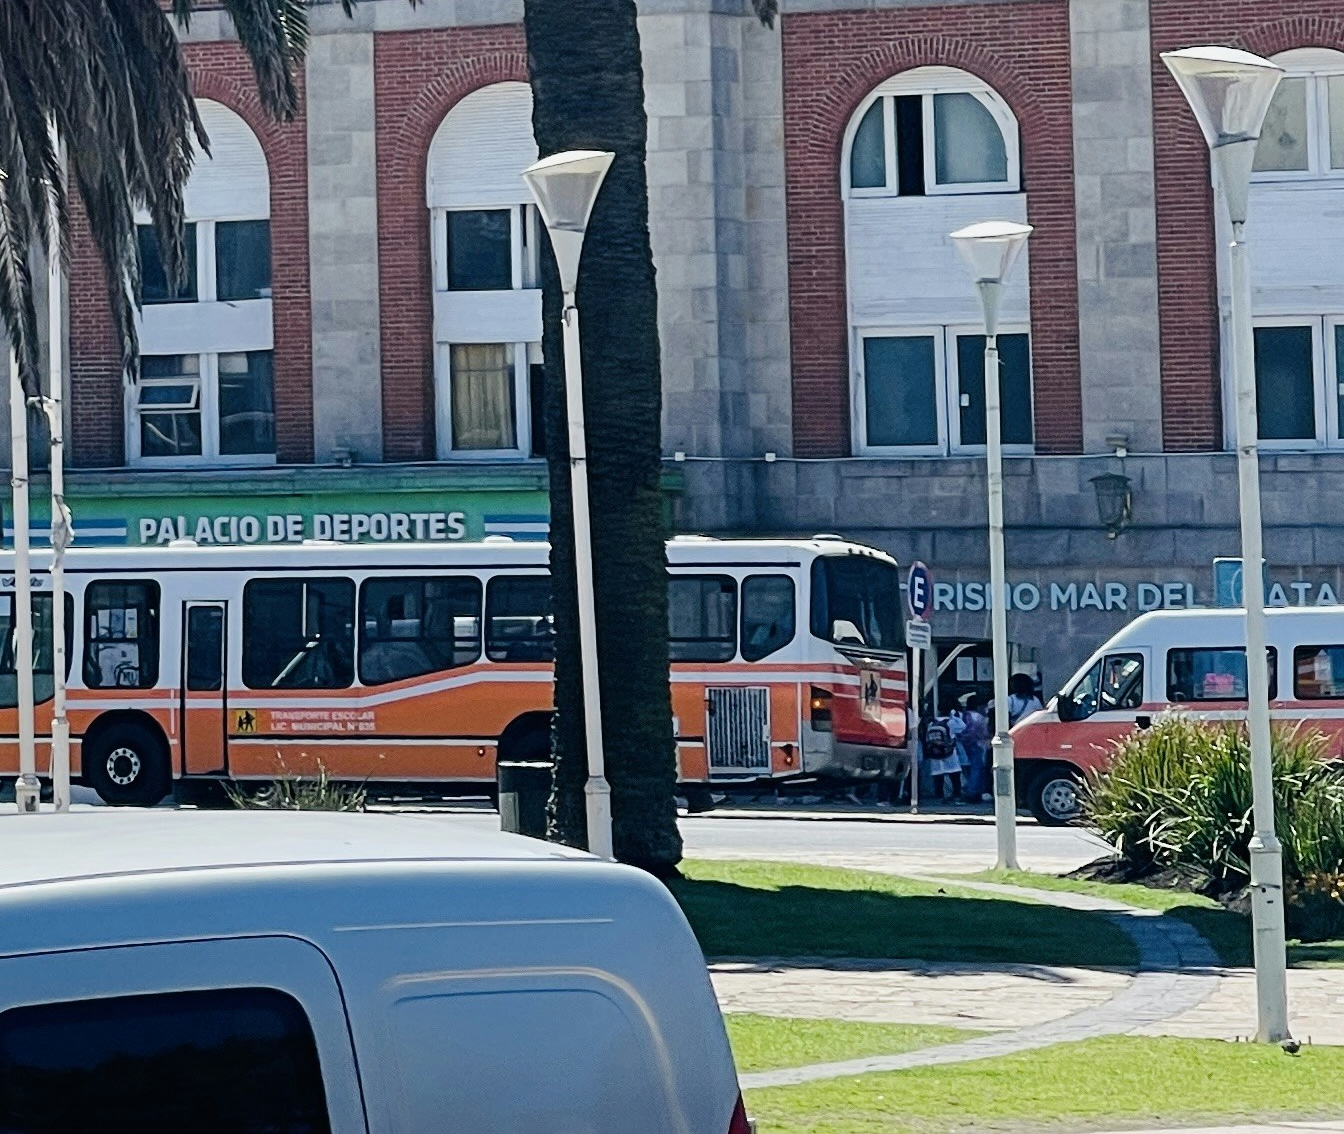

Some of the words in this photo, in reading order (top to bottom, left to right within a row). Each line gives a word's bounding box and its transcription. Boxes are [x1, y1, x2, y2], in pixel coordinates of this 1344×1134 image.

[139, 515, 260, 543] PALACIO
[267, 515, 303, 542] DE
[313, 512, 465, 541] DEPORTES
[899, 582, 1041, 611] RISMO
[1050, 582, 1128, 611] MAR
[1137, 582, 1206, 611] DEL
[1268, 582, 1339, 607] ATA
[914, 577, 925, 609] E
